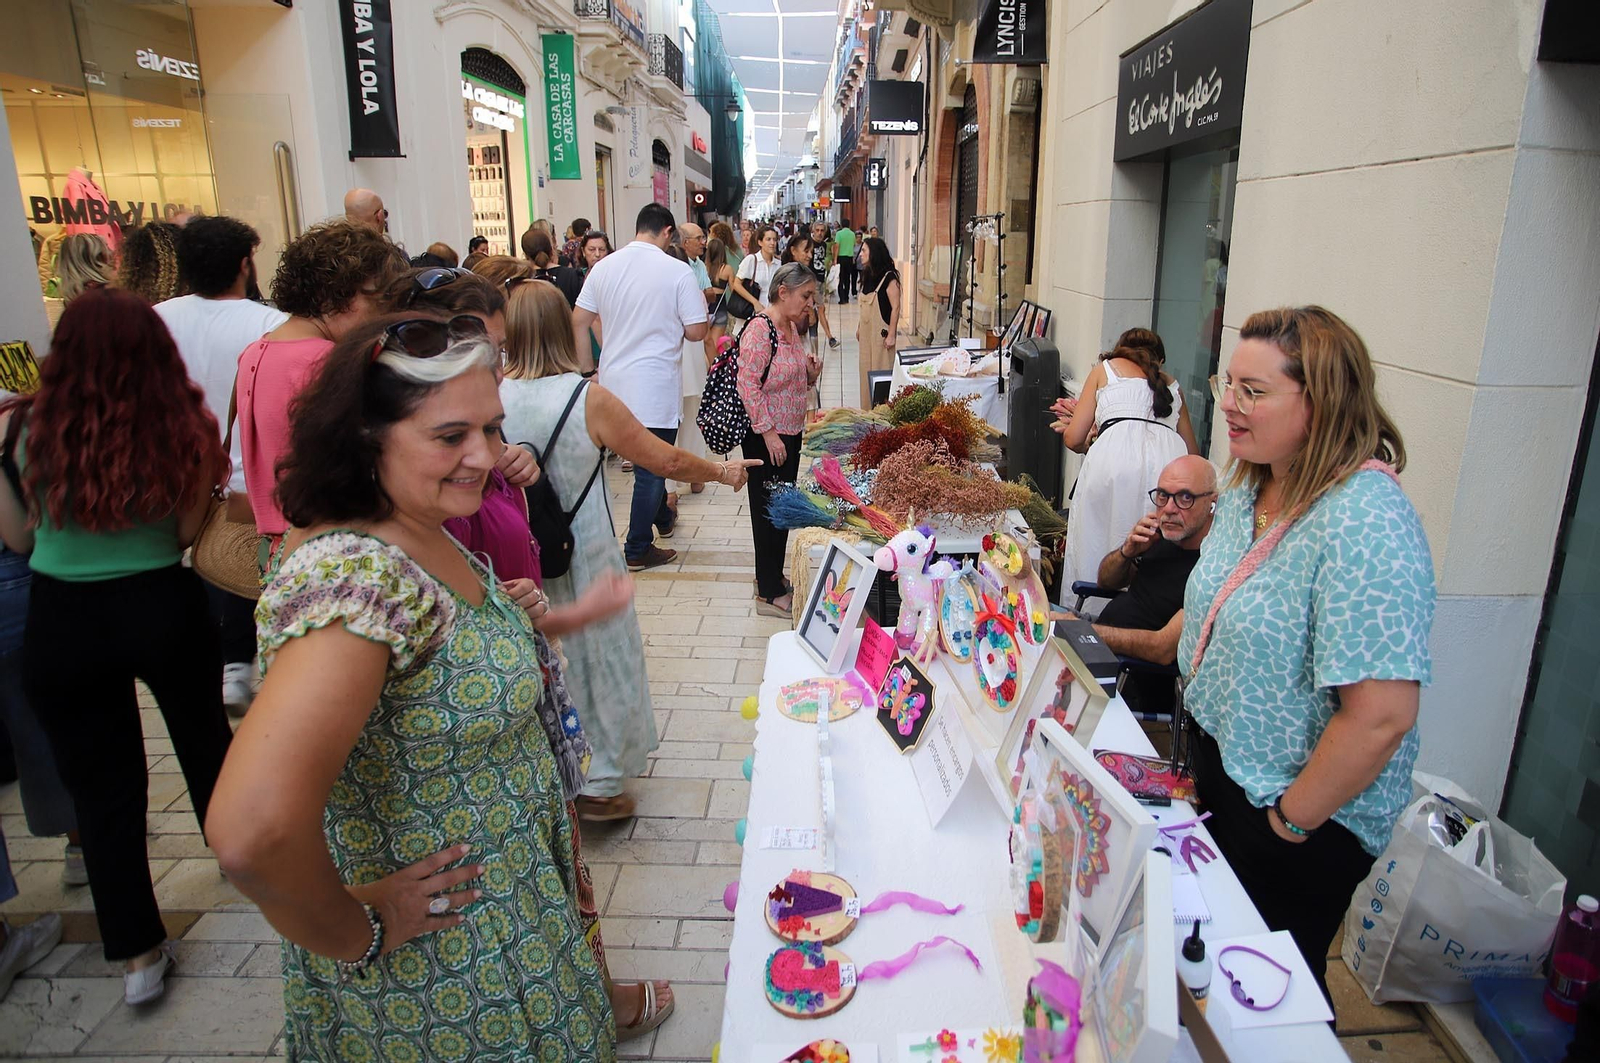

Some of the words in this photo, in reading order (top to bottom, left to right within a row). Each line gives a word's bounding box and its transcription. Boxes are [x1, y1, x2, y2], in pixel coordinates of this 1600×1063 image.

[1018, 2, 1027, 31] GESTION
[356, 37, 376, 55] Y
[1131, 40, 1174, 82] VIAJES
[548, 53, 559, 79] LAS
[358, 59, 380, 116] LOLA
[550, 83, 560, 102] DE
[1140, 92, 1169, 131] Corte
[1168, 66, 1223, 136] Inglés
[550, 104, 562, 139] CASA
[560, 72, 573, 144] CARCASAS
[871, 119, 919, 131] TEZENIS
[553, 143, 564, 162] LA
[29, 195, 128, 226] BIMBA
[127, 201, 145, 227] Y
[926, 738, 952, 798] personalizados
